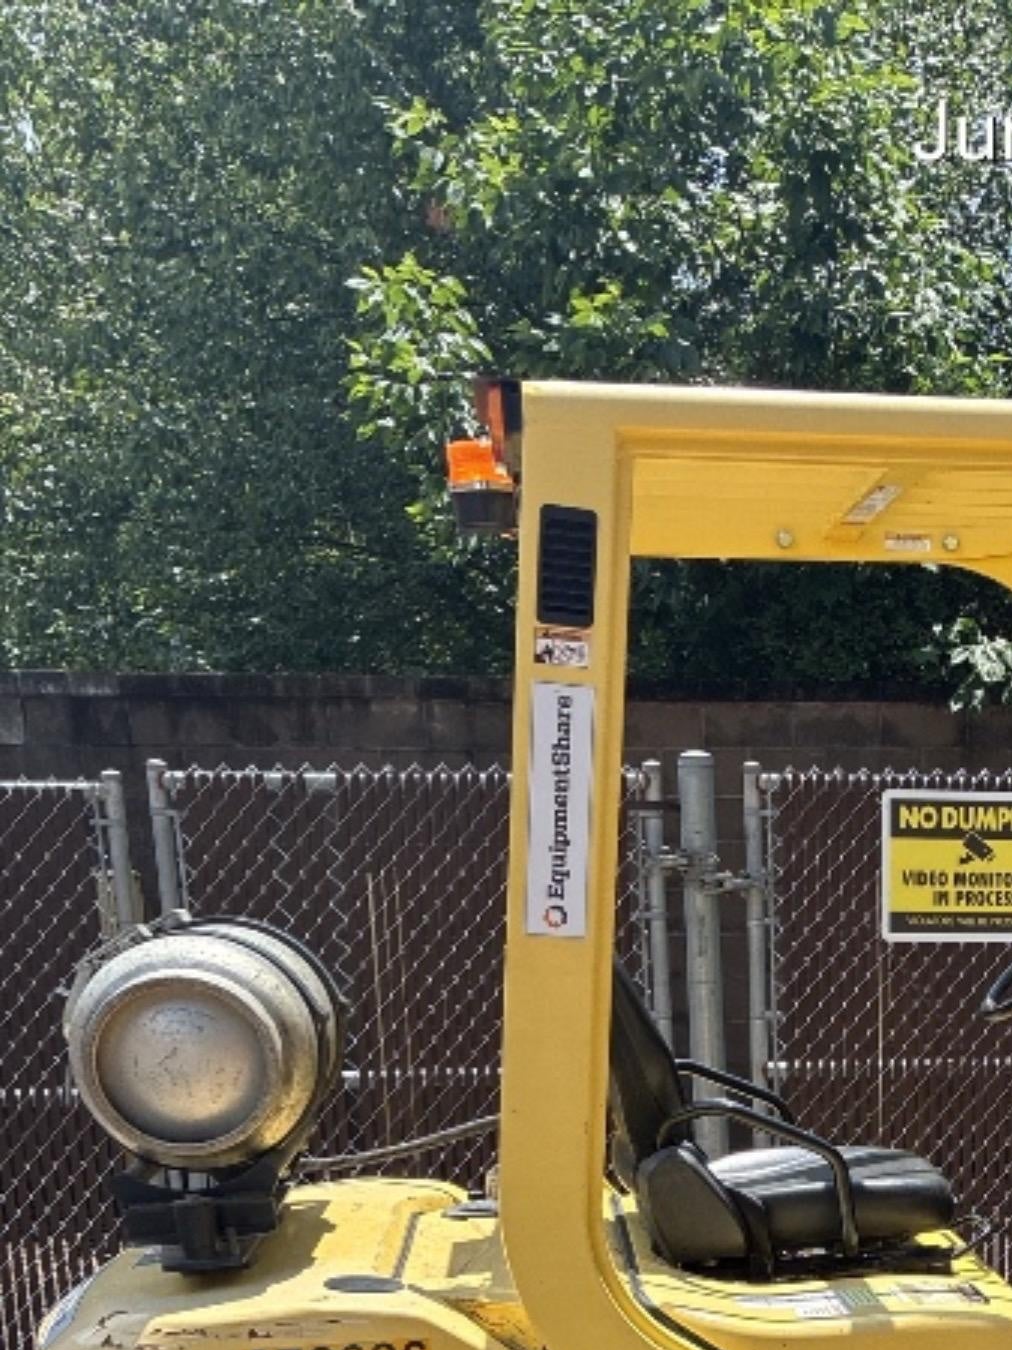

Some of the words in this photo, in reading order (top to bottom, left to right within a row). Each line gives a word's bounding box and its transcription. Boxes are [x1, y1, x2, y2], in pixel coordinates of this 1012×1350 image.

[547, 694, 574, 901] EquipmentShare
[900, 805, 937, 830] NO
[902, 869, 949, 887] VIDEO
[932, 890, 949, 907] IN
